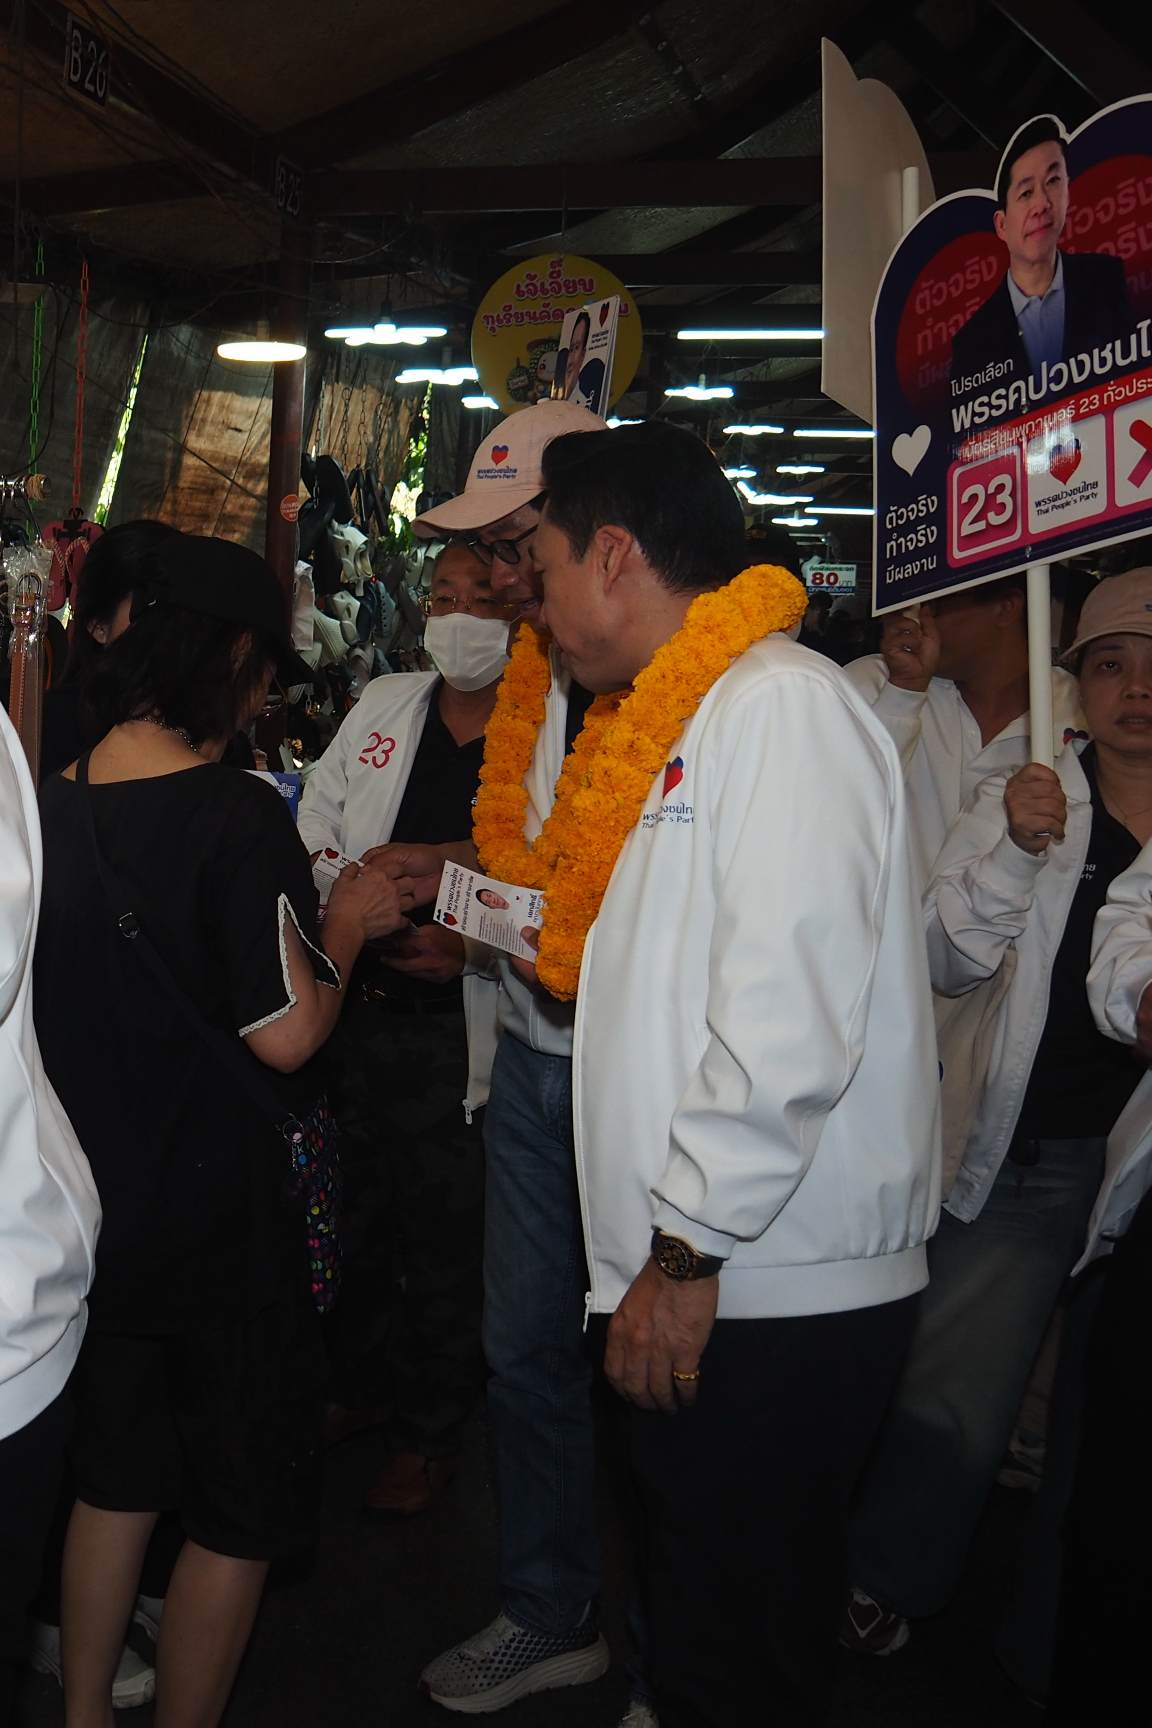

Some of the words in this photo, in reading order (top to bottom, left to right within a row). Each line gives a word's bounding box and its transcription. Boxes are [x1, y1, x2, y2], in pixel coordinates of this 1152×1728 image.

[70, 28, 82, 83] B
[84, 40, 108, 98] 26
[915, 255, 998, 315] ตัวจริง
[917, 296, 981, 356] ทำจริ
[950, 358, 1014, 397] โปรดเลือก
[1079, 394, 1100, 414] 23
[886, 494, 938, 529] ตัวจริง
[960, 472, 1015, 537] 23
[1079, 491, 1099, 506] Party
[886, 524, 938, 560] ทำจริง
[811, 571, 839, 586] 80
[886, 555, 937, 585] มีผลงาน
[358, 731, 397, 769] 23
